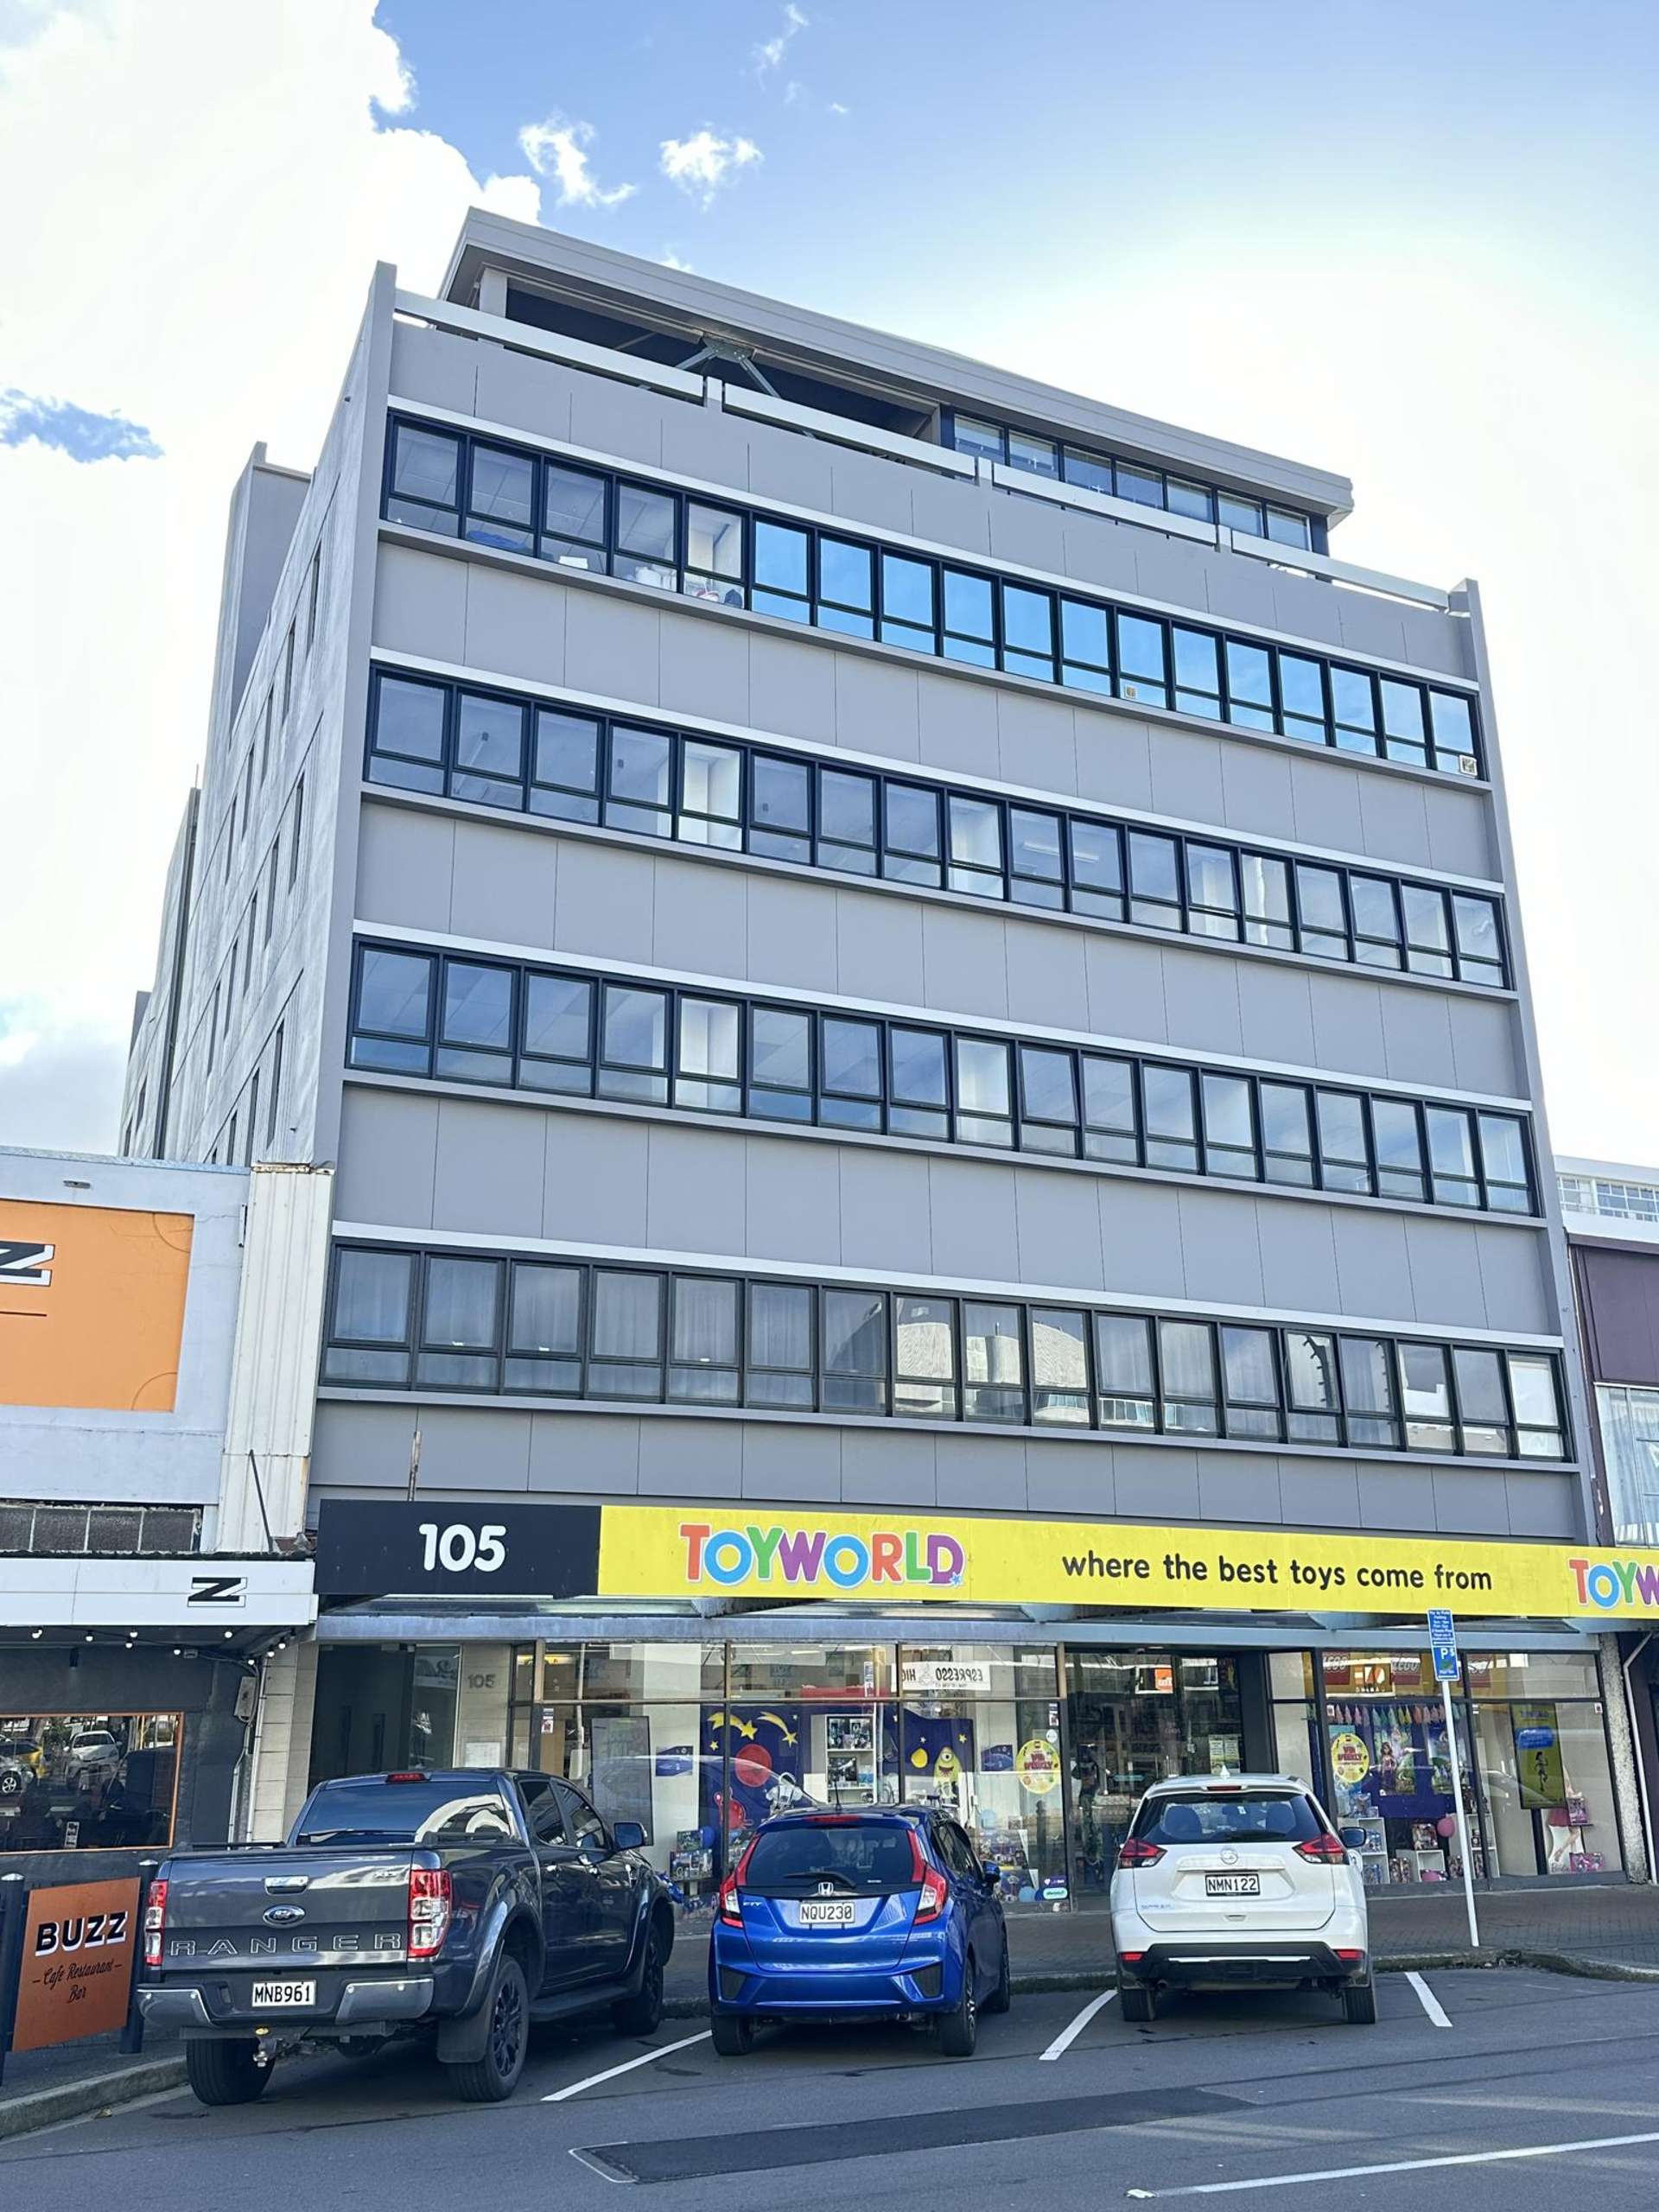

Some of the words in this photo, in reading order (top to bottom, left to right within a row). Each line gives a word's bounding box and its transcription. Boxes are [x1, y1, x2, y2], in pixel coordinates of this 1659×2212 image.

[418, 1523, 506, 1572] 105
[679, 1522, 965, 1589] TOYWORLD
[1062, 1550, 1150, 1579] where
[1163, 1554, 1208, 1581] the
[1219, 1555, 1279, 1584] best
[1289, 1559, 1345, 1591] toys
[1357, 1567, 1424, 1588] come
[1433, 1564, 1492, 1591] from
[1440, 1648, 1448, 1660] P
[467, 1674, 496, 1689] 105
[1207, 1877, 1257, 1891] NMN122
[800, 1905, 854, 1921] NQU230
[35, 1910, 128, 1957] BUZZ
[170, 1932, 401, 1956] RANGER
[43, 1965, 65, 1991] Cafe
[67, 1958, 115, 1982] Restaurant
[68, 1984, 87, 2004] Bar
[254, 1984, 311, 2004] MNB961
